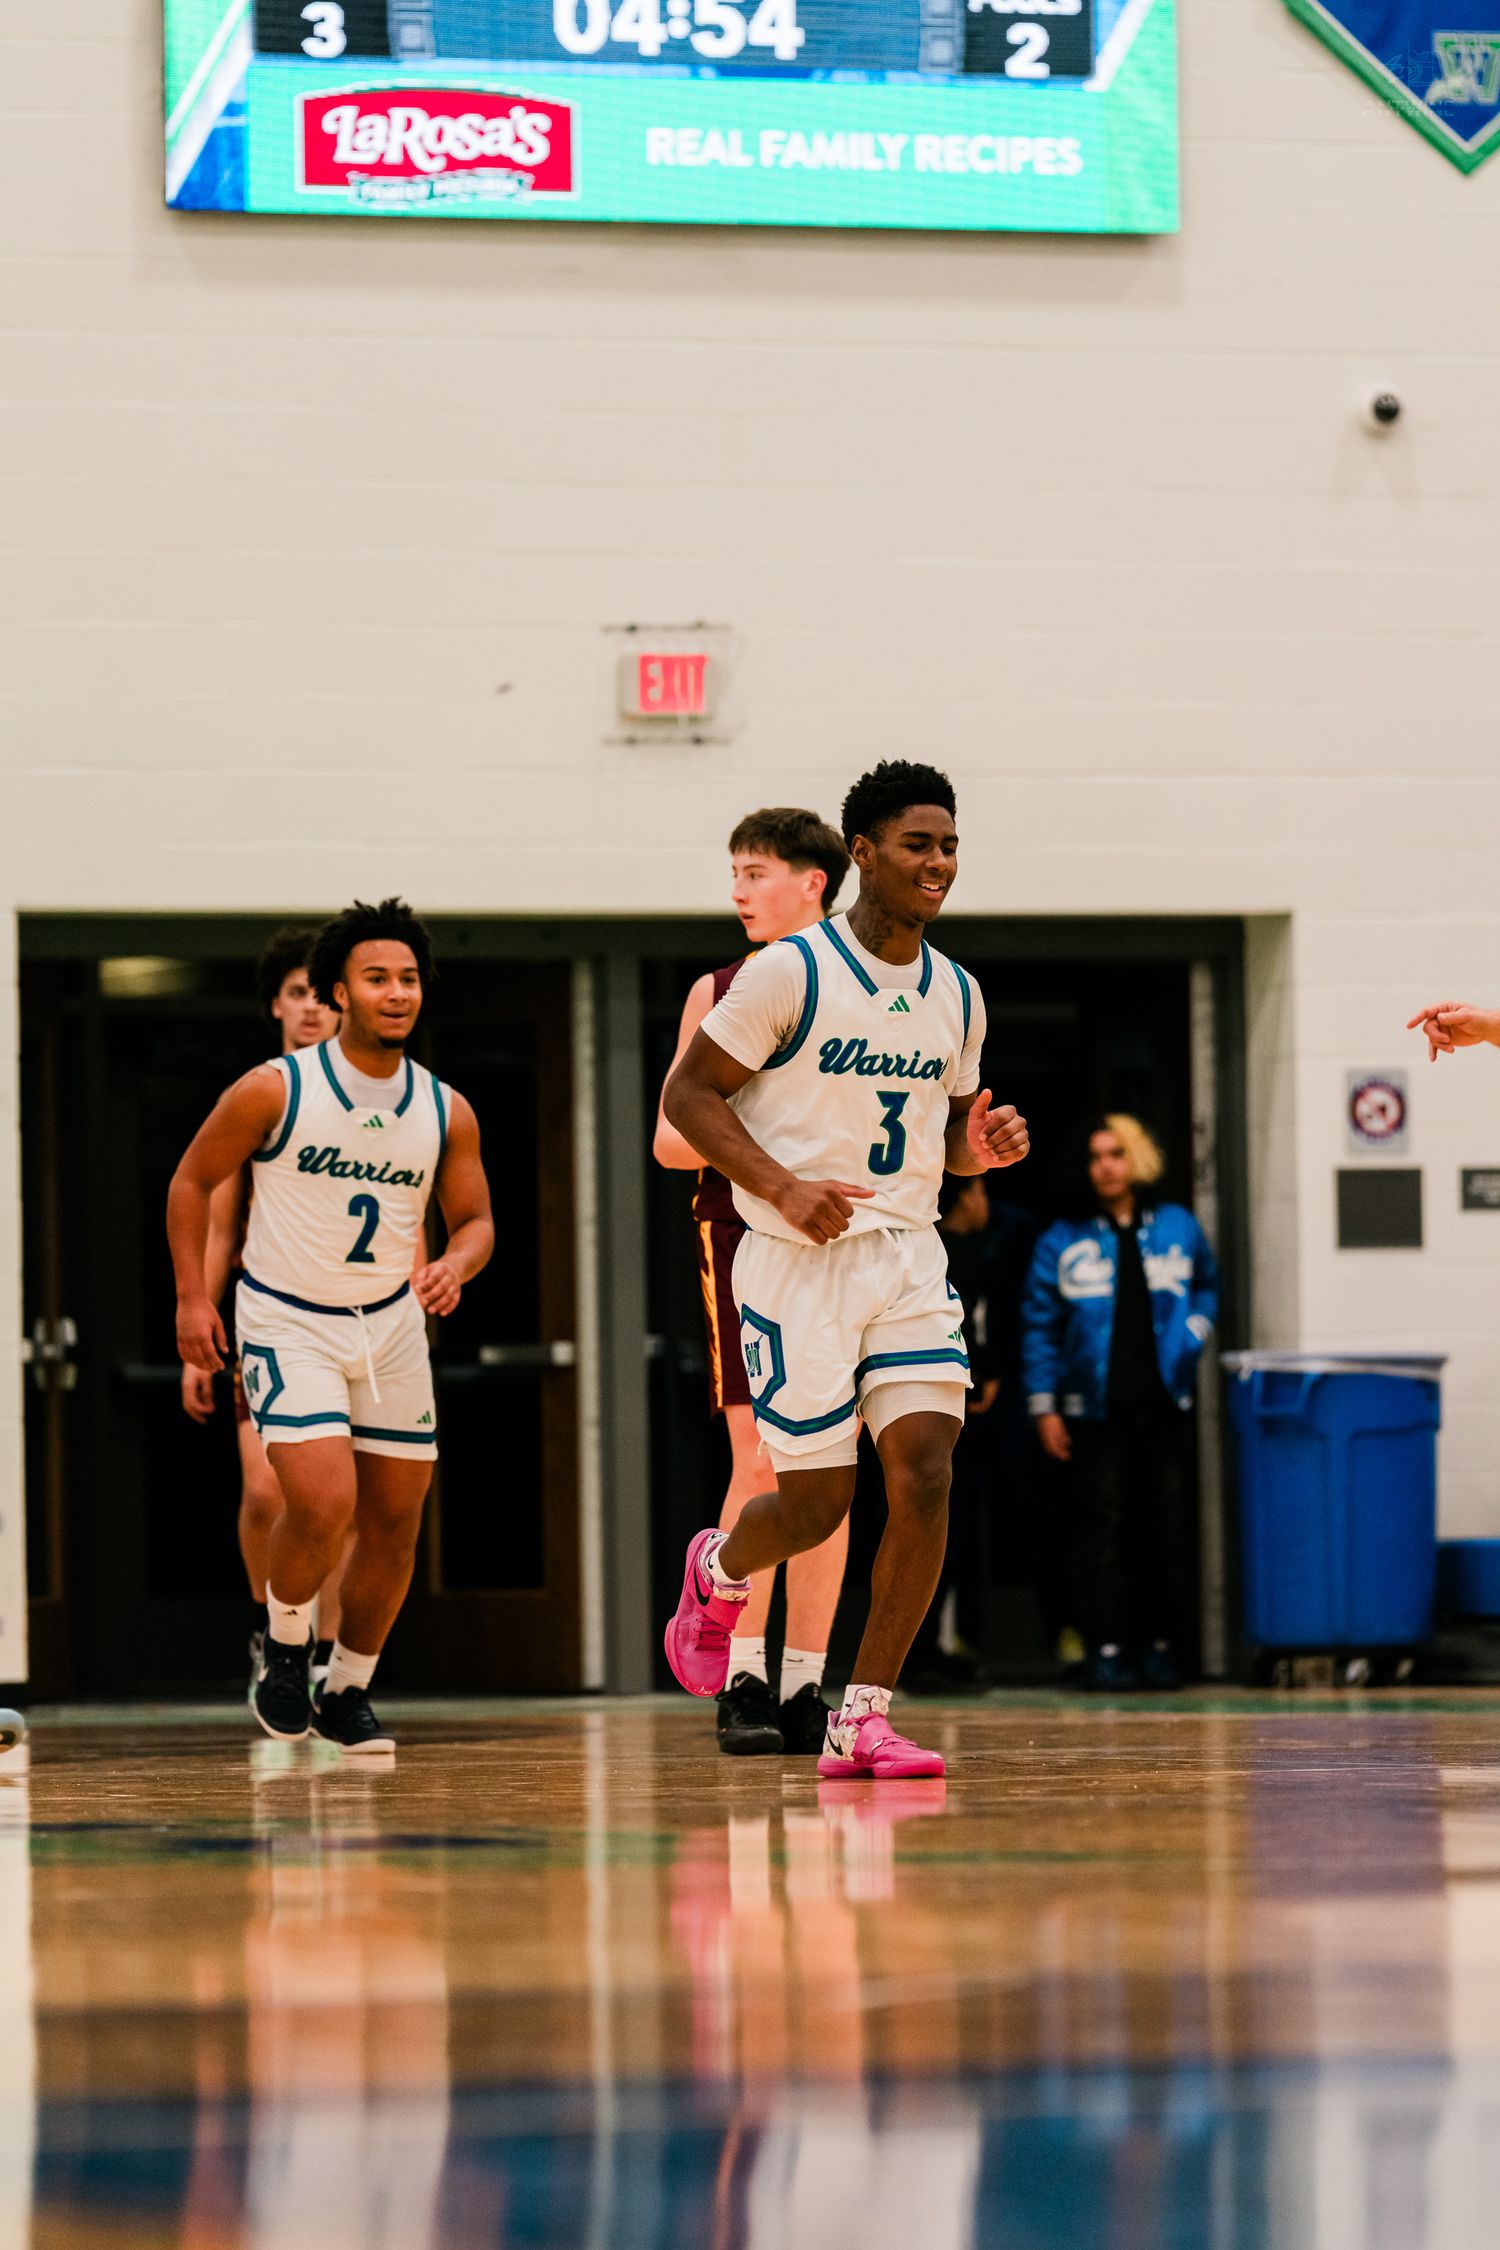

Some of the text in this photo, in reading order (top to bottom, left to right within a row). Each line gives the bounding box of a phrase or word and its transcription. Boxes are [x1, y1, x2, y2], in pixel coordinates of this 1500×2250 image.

[300, 2, 347, 58] 3
[552, 0, 806, 60] 04:54
[1004, 22, 1051, 79] 2
[645, 126, 1084, 177] REAL FAMILY RECIPES
[638, 654, 707, 714] EXIT
[818, 1038, 949, 1081] Warrior
[867, 1090, 911, 1176] 3
[345, 1193, 380, 1264] 2
